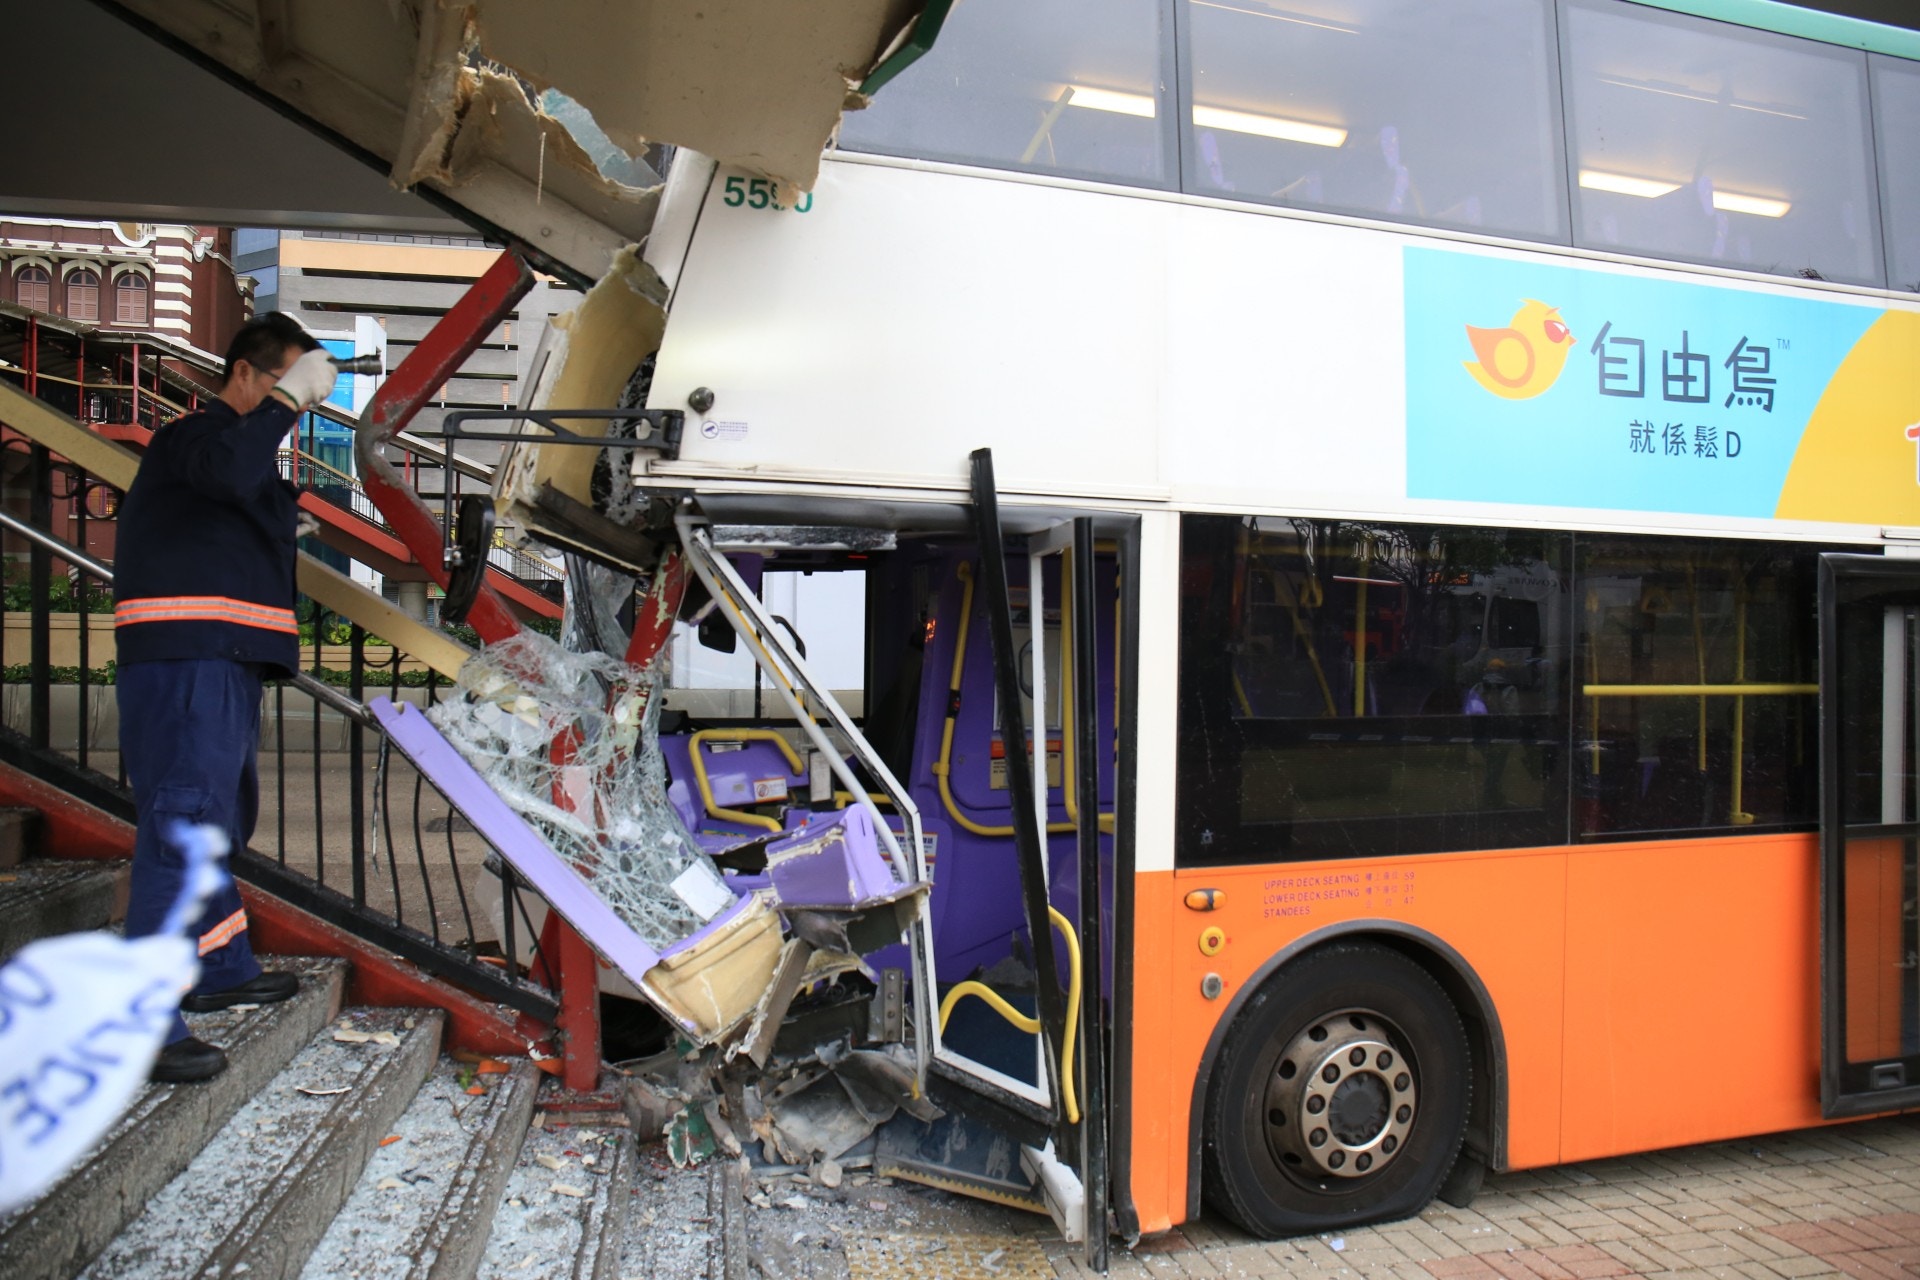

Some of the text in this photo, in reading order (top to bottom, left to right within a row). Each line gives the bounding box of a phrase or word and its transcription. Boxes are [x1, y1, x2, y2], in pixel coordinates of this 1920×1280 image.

[1590, 320, 1777, 413] 自由鳥
[1264, 879, 1294, 890] UPPER
[1296, 877, 1320, 888] DECK
[1322, 874, 1360, 886] SEATING
[1263, 892, 1295, 905] LOWER
[1297, 890, 1321, 902] DECK
[1323, 888, 1360, 900] SEATING
[1263, 905, 1311, 918] STANDEES
